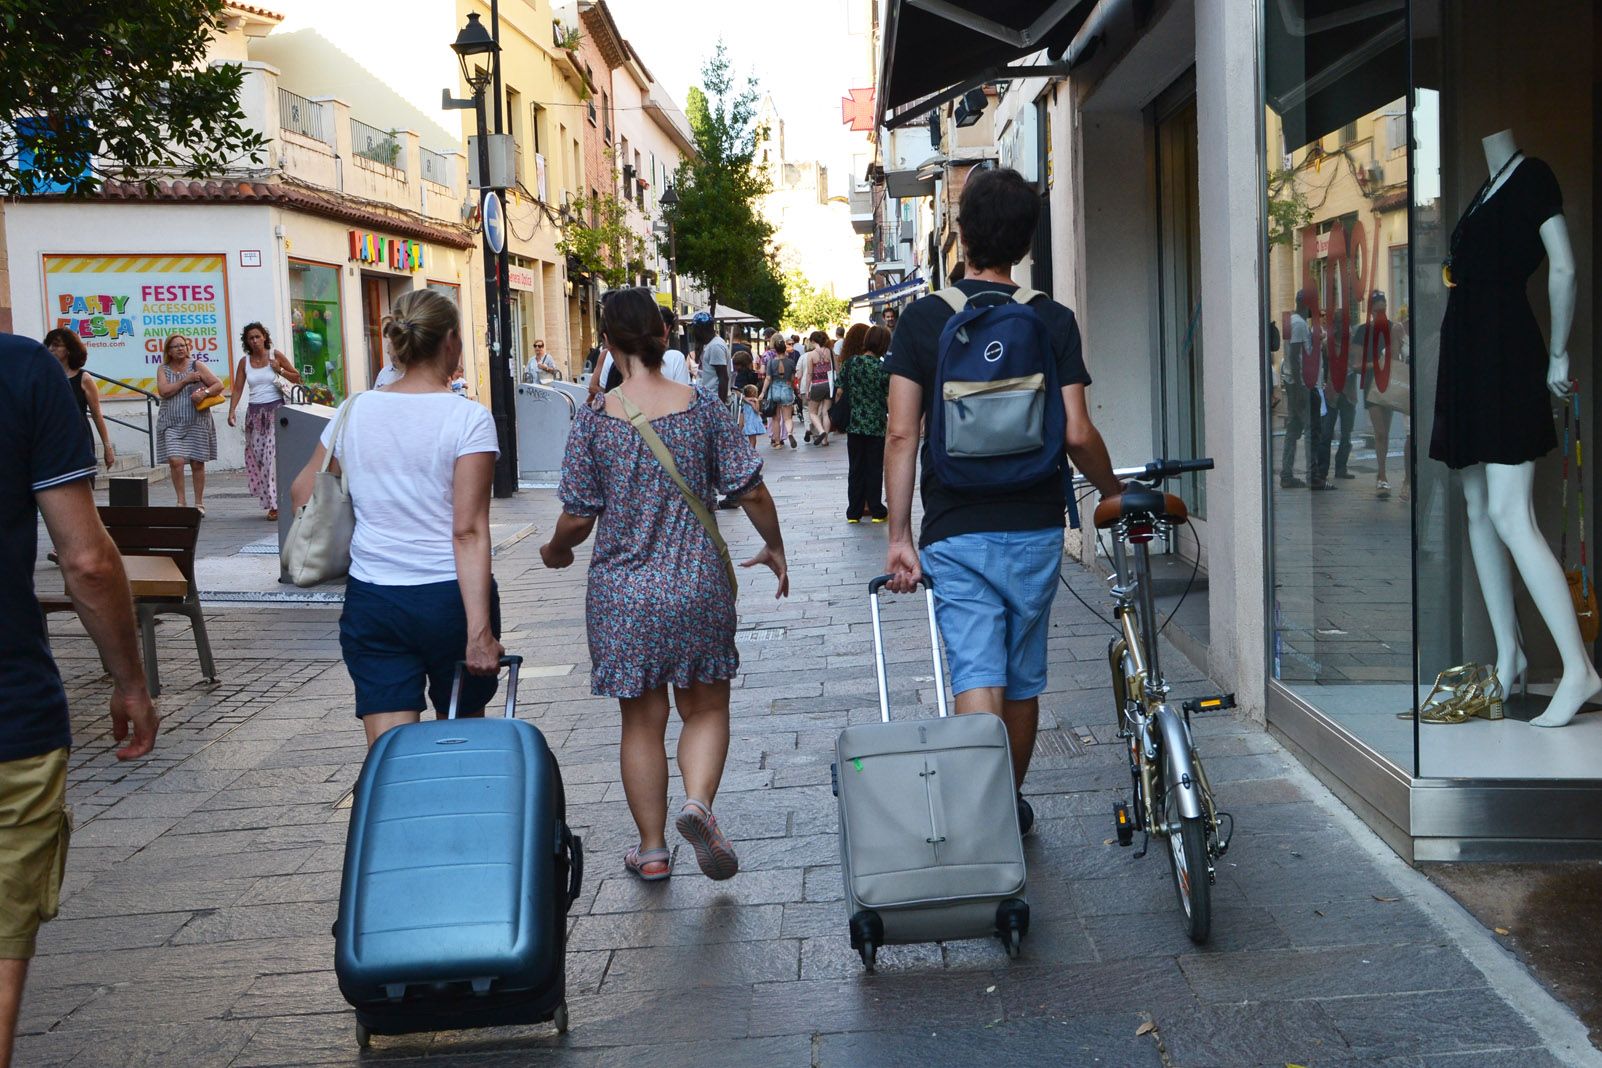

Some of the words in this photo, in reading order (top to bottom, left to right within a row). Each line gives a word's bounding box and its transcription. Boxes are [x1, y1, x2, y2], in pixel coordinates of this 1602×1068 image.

[349, 230, 385, 265] PARTY
[388, 239, 424, 272] FIESTA
[142, 285, 215, 301] FESTES
[58, 293, 129, 315] PARTY
[143, 303, 216, 313] ACCESSORIS
[57, 316, 135, 339] FIESTA
[143, 314, 217, 326] DISFRESSES
[143, 327, 218, 337] ANIVERSARIS
